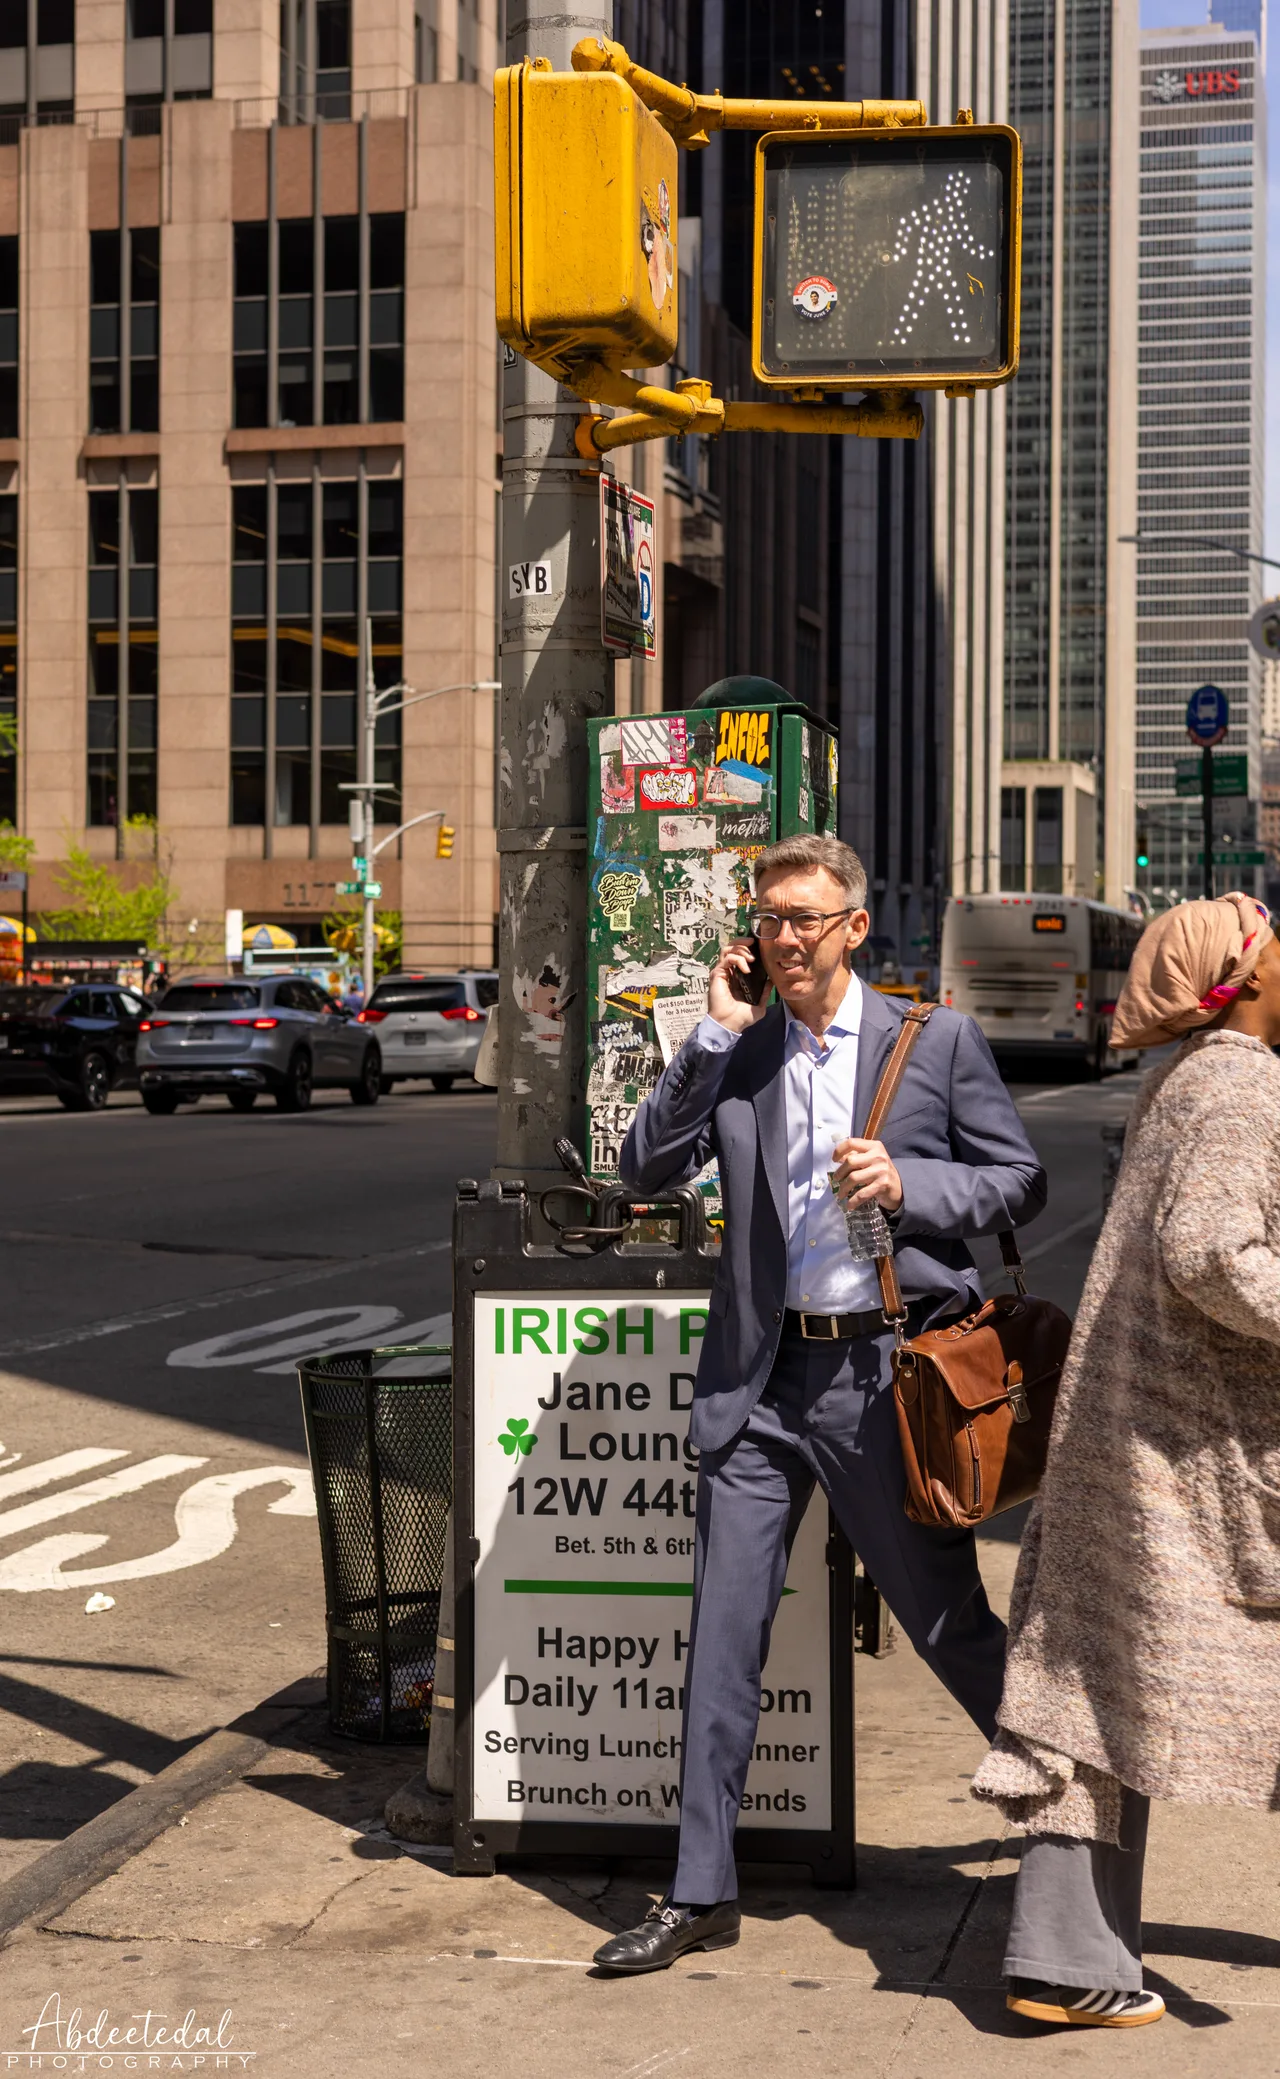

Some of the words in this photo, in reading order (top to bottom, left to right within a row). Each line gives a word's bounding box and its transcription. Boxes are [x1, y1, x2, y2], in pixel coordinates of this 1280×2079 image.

[1185, 69, 1240, 96] UBS
[512, 563, 547, 594] SYB
[602, 886, 637, 904] Down
[605, 897, 635, 914] Boyz
[670, 1000, 684, 1008] $150
[685, 998, 704, 1007] Easily
[680, 1006, 701, 1015] Hours!
[495, 1307, 654, 1355] IRISH
[537, 1372, 651, 1411] Jane
[508, 1477, 608, 1517] 12W
[555, 1536, 596, 1554] Bet.
[603, 1536, 636, 1555] 5th
[643, 1537, 659, 1555] &
[537, 1627, 660, 1669] Happy
[504, 1675, 598, 1716] Daily
[484, 1730, 590, 1762] Serving
[599, 1734, 683, 1759] Lunch
[748, 1743, 821, 1763] nner
[507, 1780, 607, 1807] Brunch
[616, 1787, 651, 1807] on
